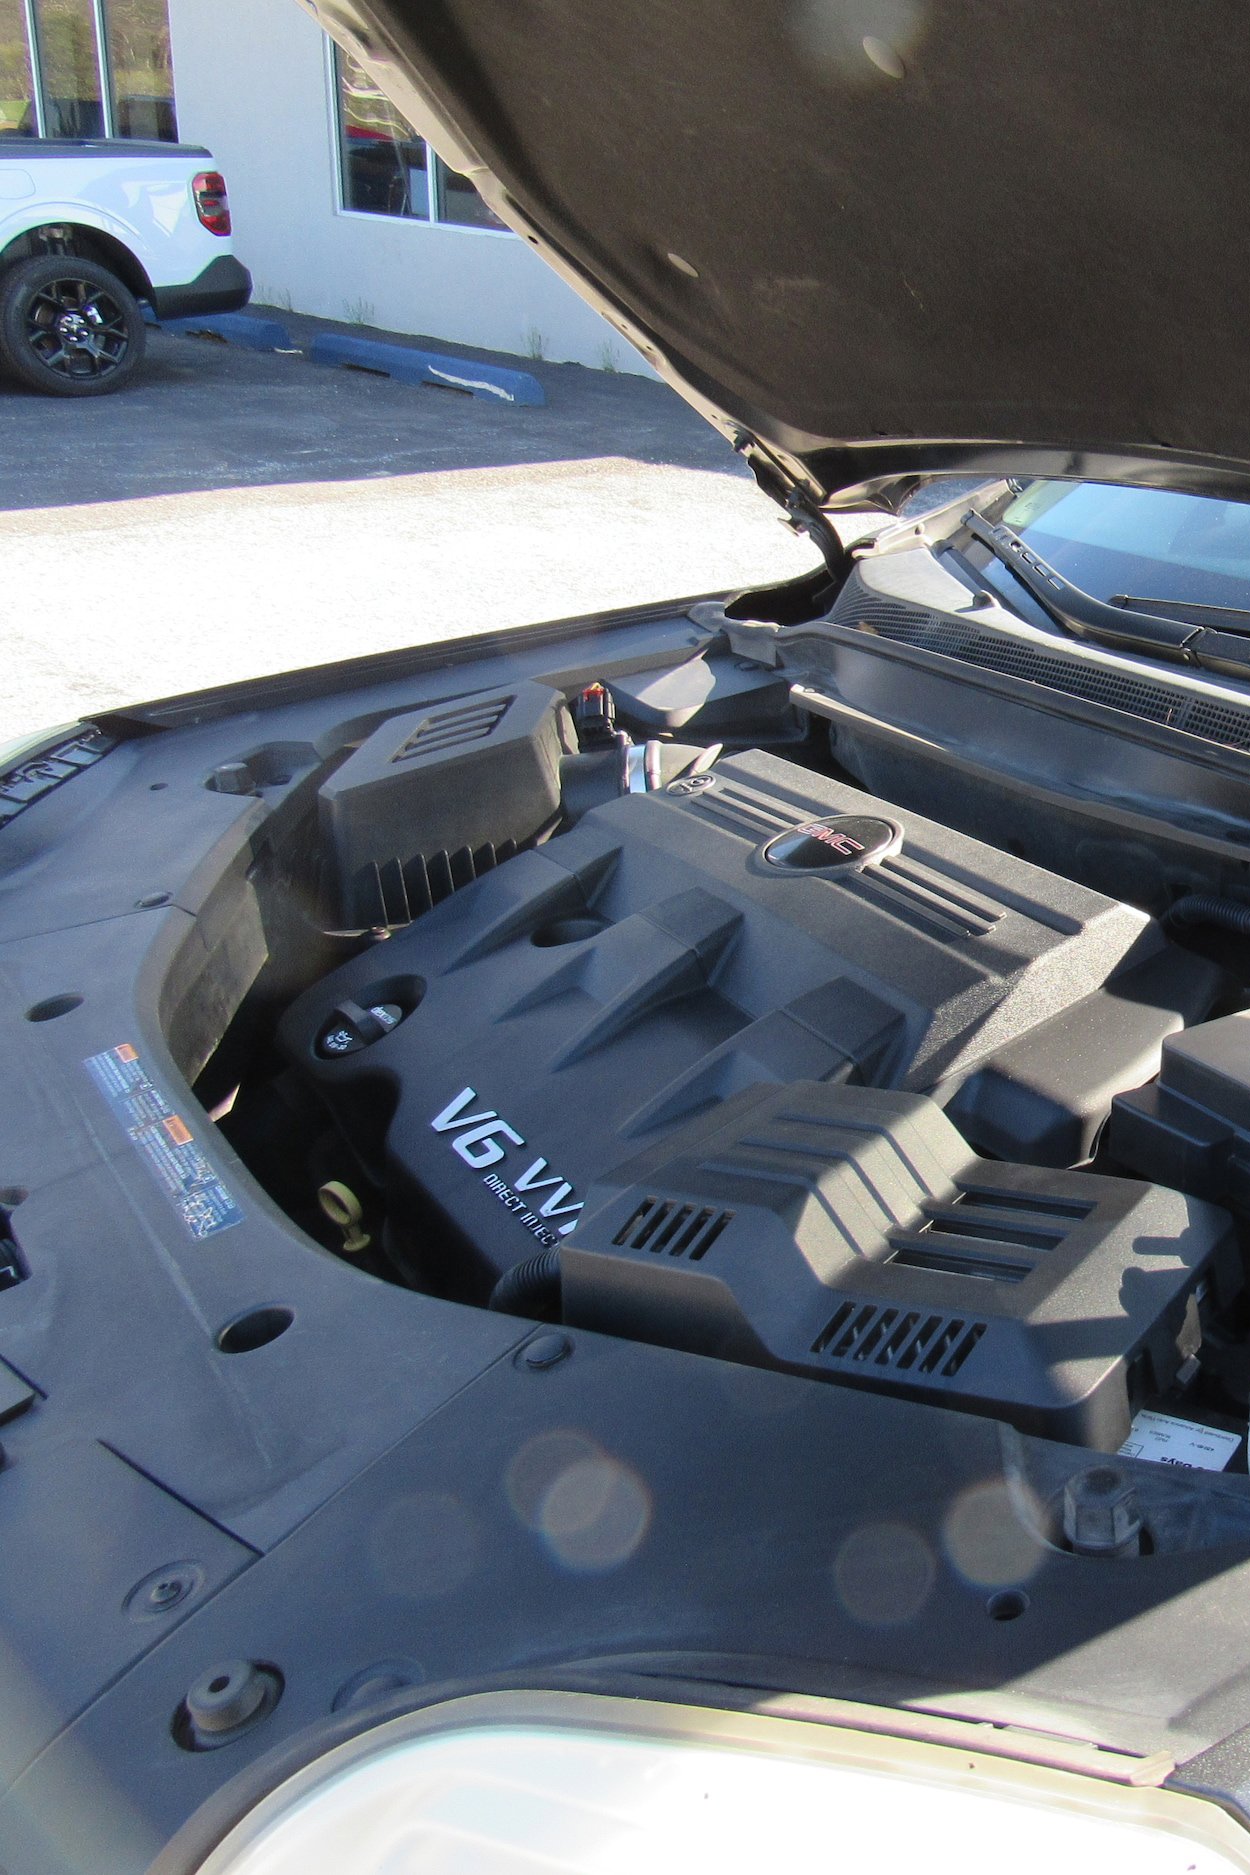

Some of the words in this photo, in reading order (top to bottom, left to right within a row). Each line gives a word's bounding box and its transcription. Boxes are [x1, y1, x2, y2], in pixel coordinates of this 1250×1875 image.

[797, 823, 866, 856] GMC
[431, 1086, 525, 1169] V6
[483, 1173, 527, 1212] DIRECT
